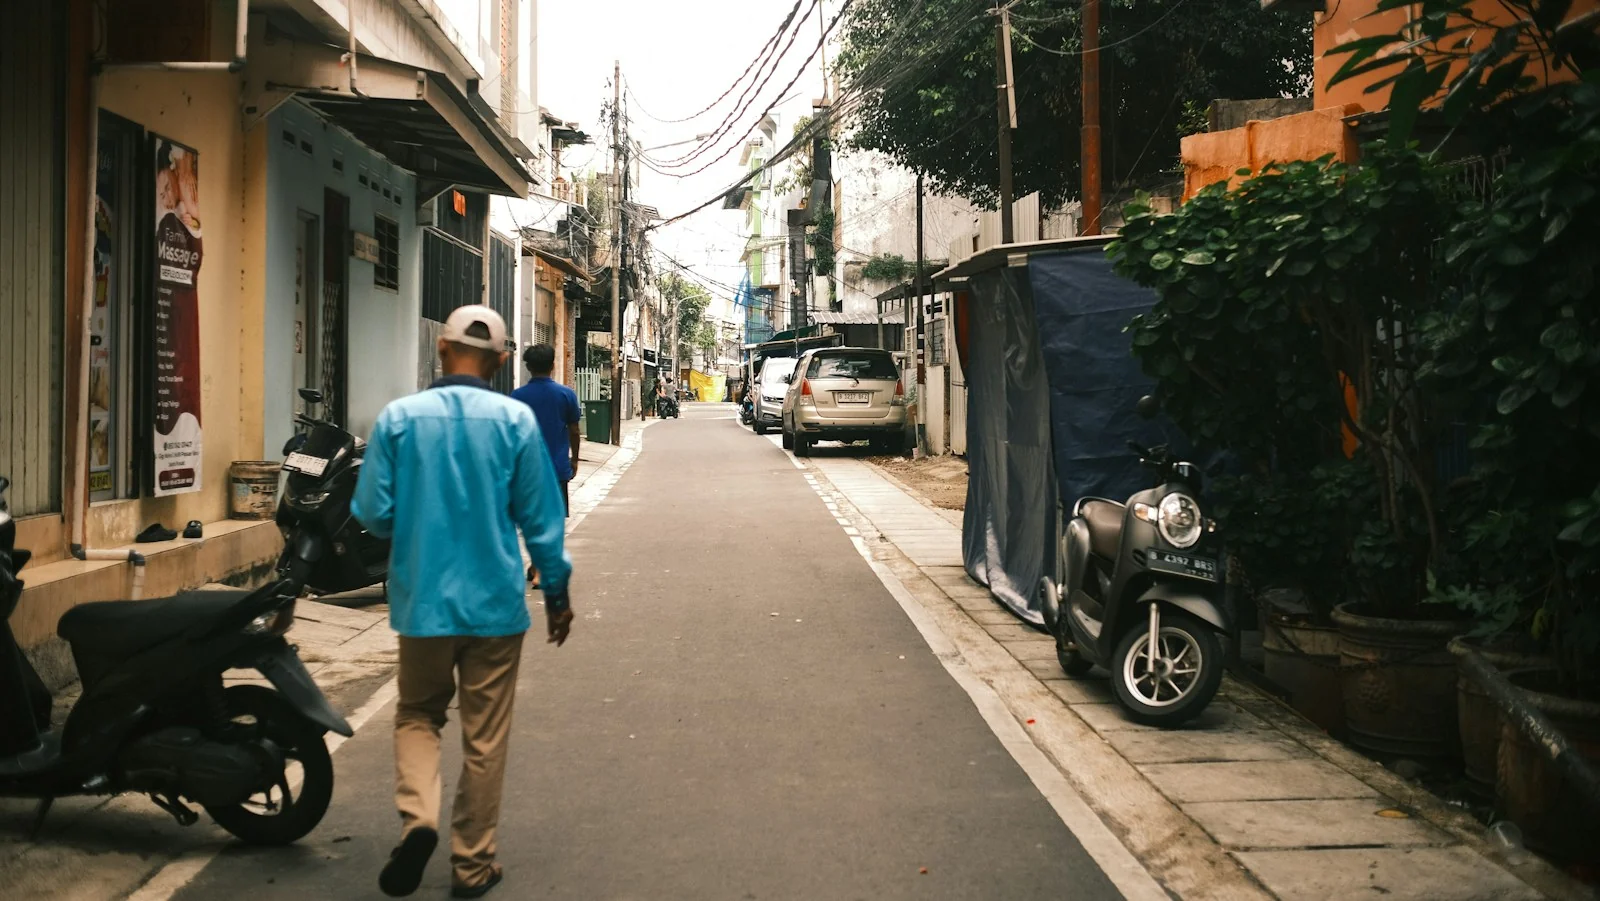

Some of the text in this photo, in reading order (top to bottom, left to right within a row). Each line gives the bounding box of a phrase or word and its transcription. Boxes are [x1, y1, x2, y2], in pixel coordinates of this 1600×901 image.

[158, 240, 199, 268] Massage
[1150, 551, 1213, 571] B 4392 BRS
